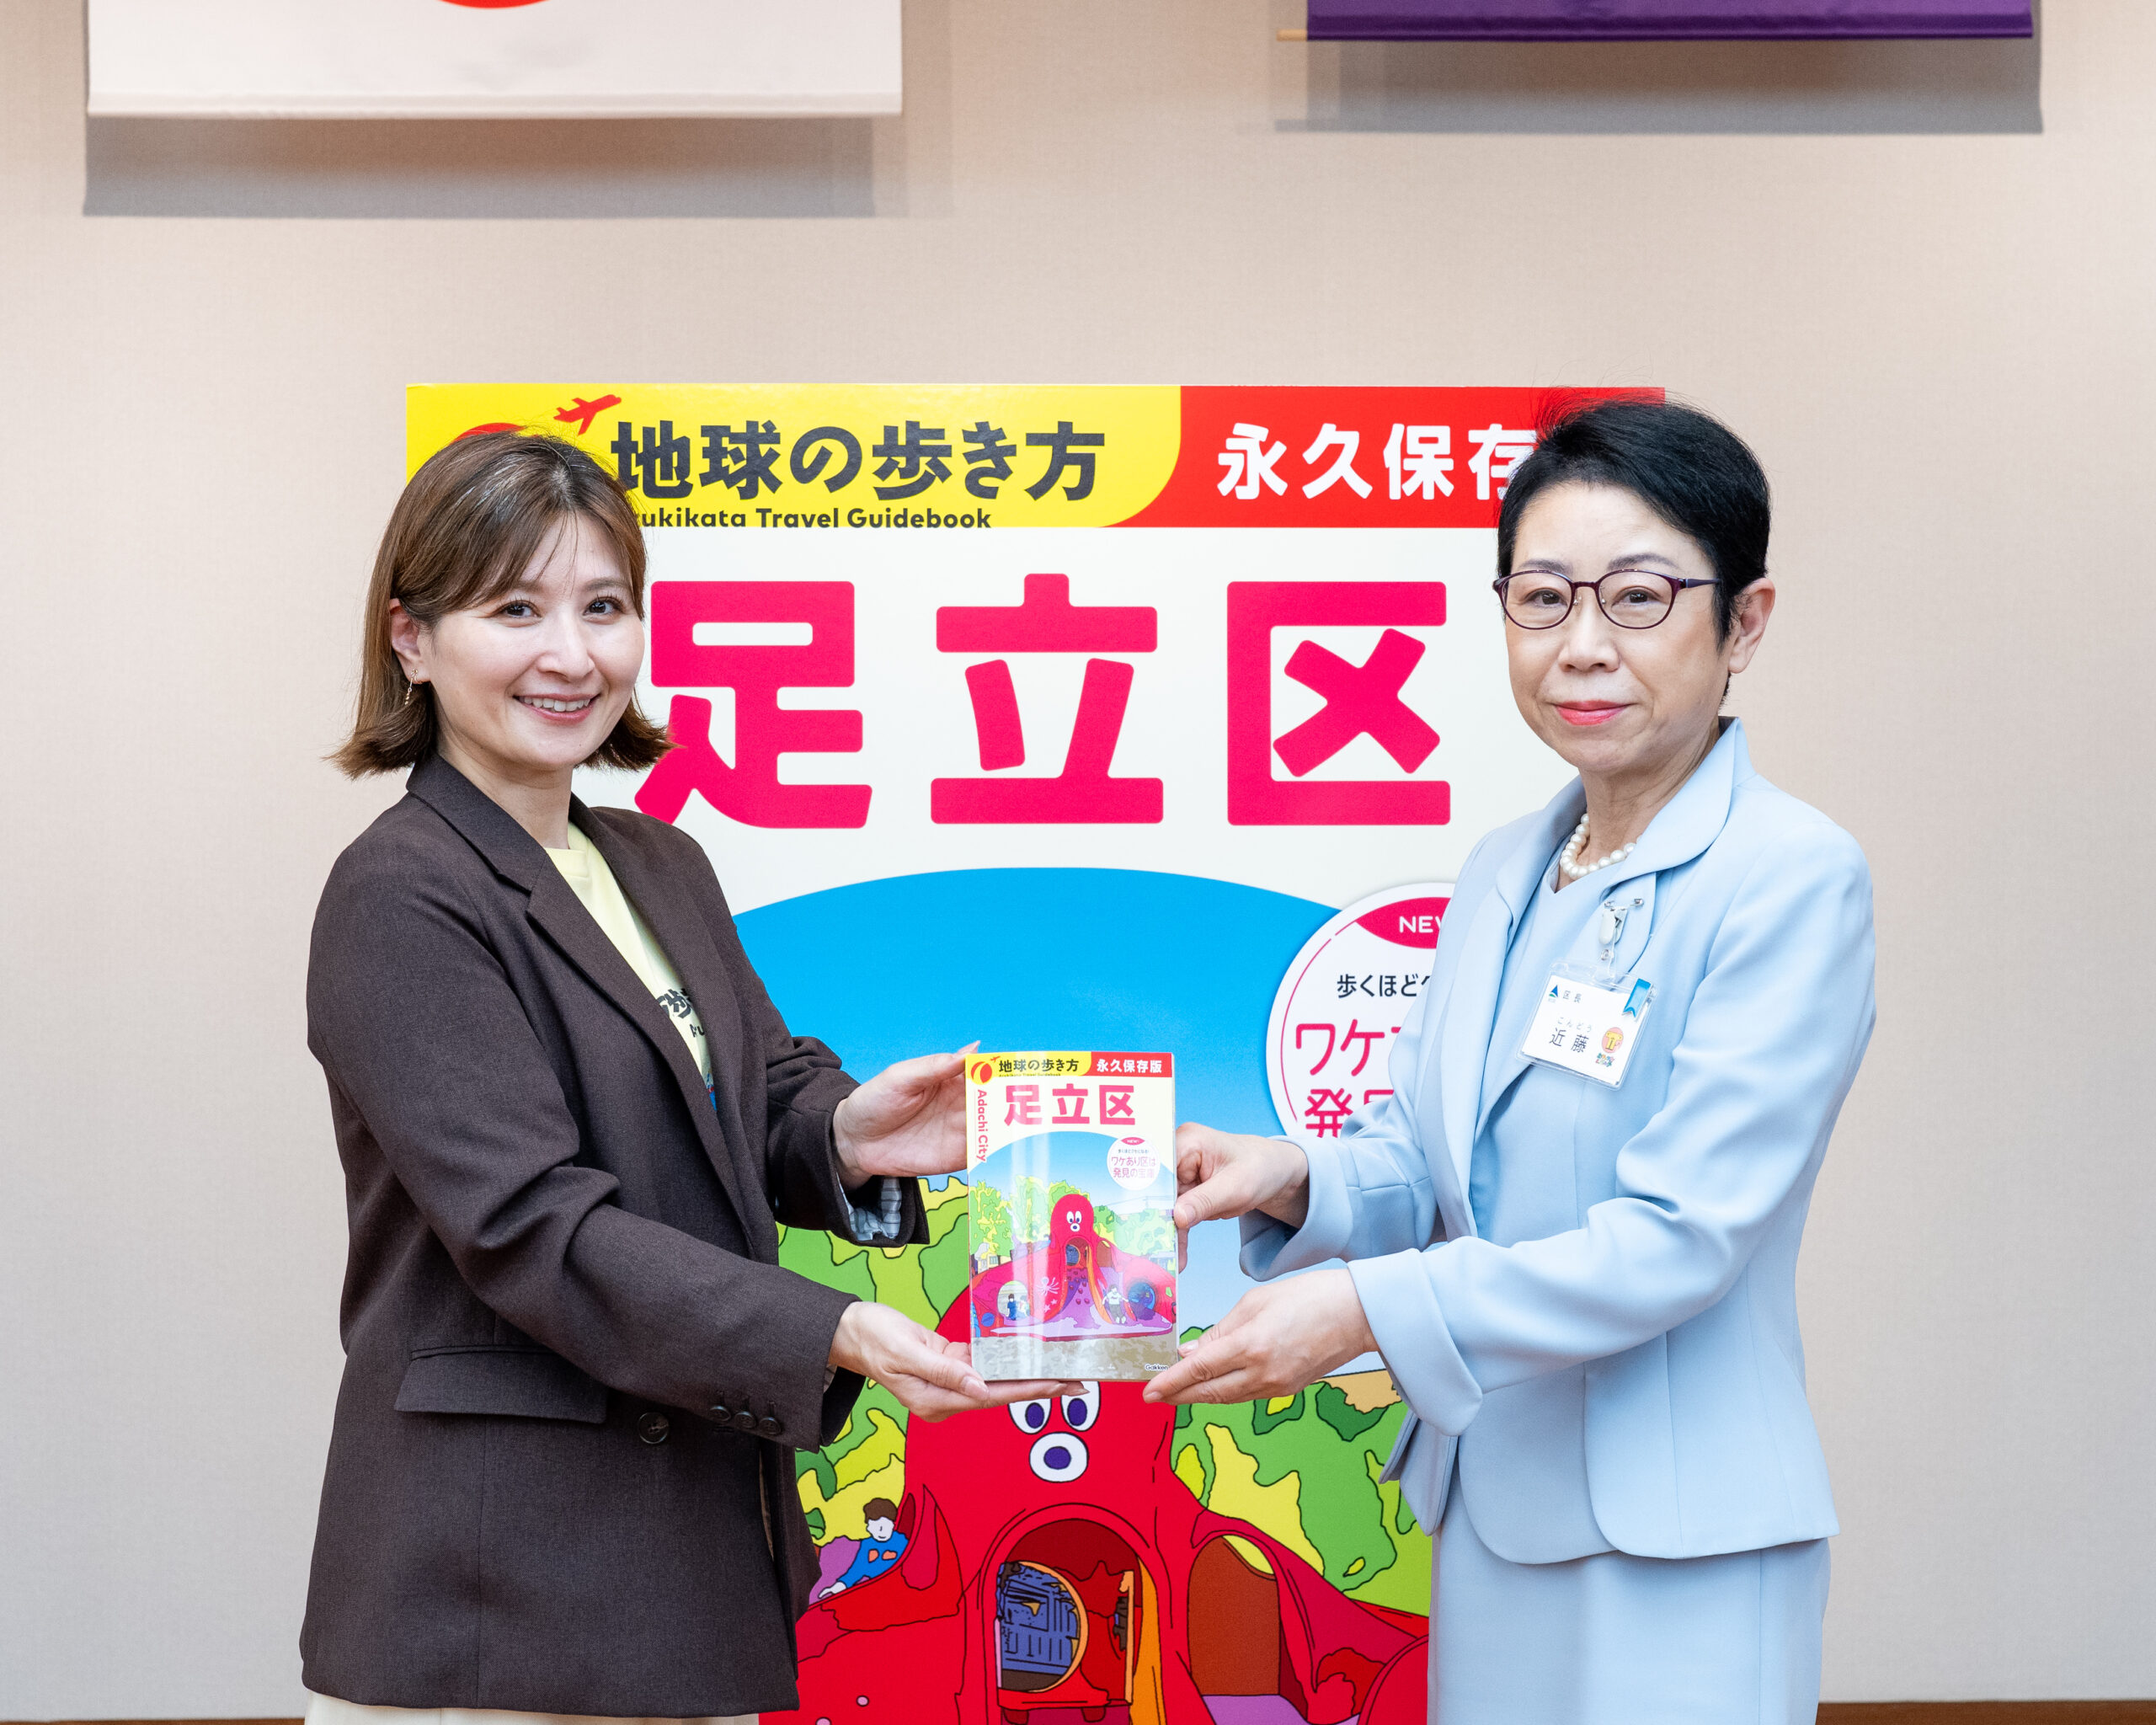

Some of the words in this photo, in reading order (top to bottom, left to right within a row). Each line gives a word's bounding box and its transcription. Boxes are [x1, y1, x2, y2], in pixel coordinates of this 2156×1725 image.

[611, 419, 1105, 500] 地球の歩き方
[755, 508, 839, 528] Travel
[847, 508, 991, 528] Guidebook
[635, 573, 1451, 829] 足立区
[1399, 916, 1441, 933] NE
[1295, 1018, 1401, 1077] ワケ
[1549, 1027, 1590, 1053] 近藤
[999, 1059, 1079, 1072] 地球の歩き方
[1097, 1058, 1162, 1073] 永久保存版
[977, 1089, 988, 1132] Adachi
[1004, 1083, 1136, 1126] 足立区
[1304, 1087, 1394, 1138] 発
[976, 1135, 989, 1162] City
